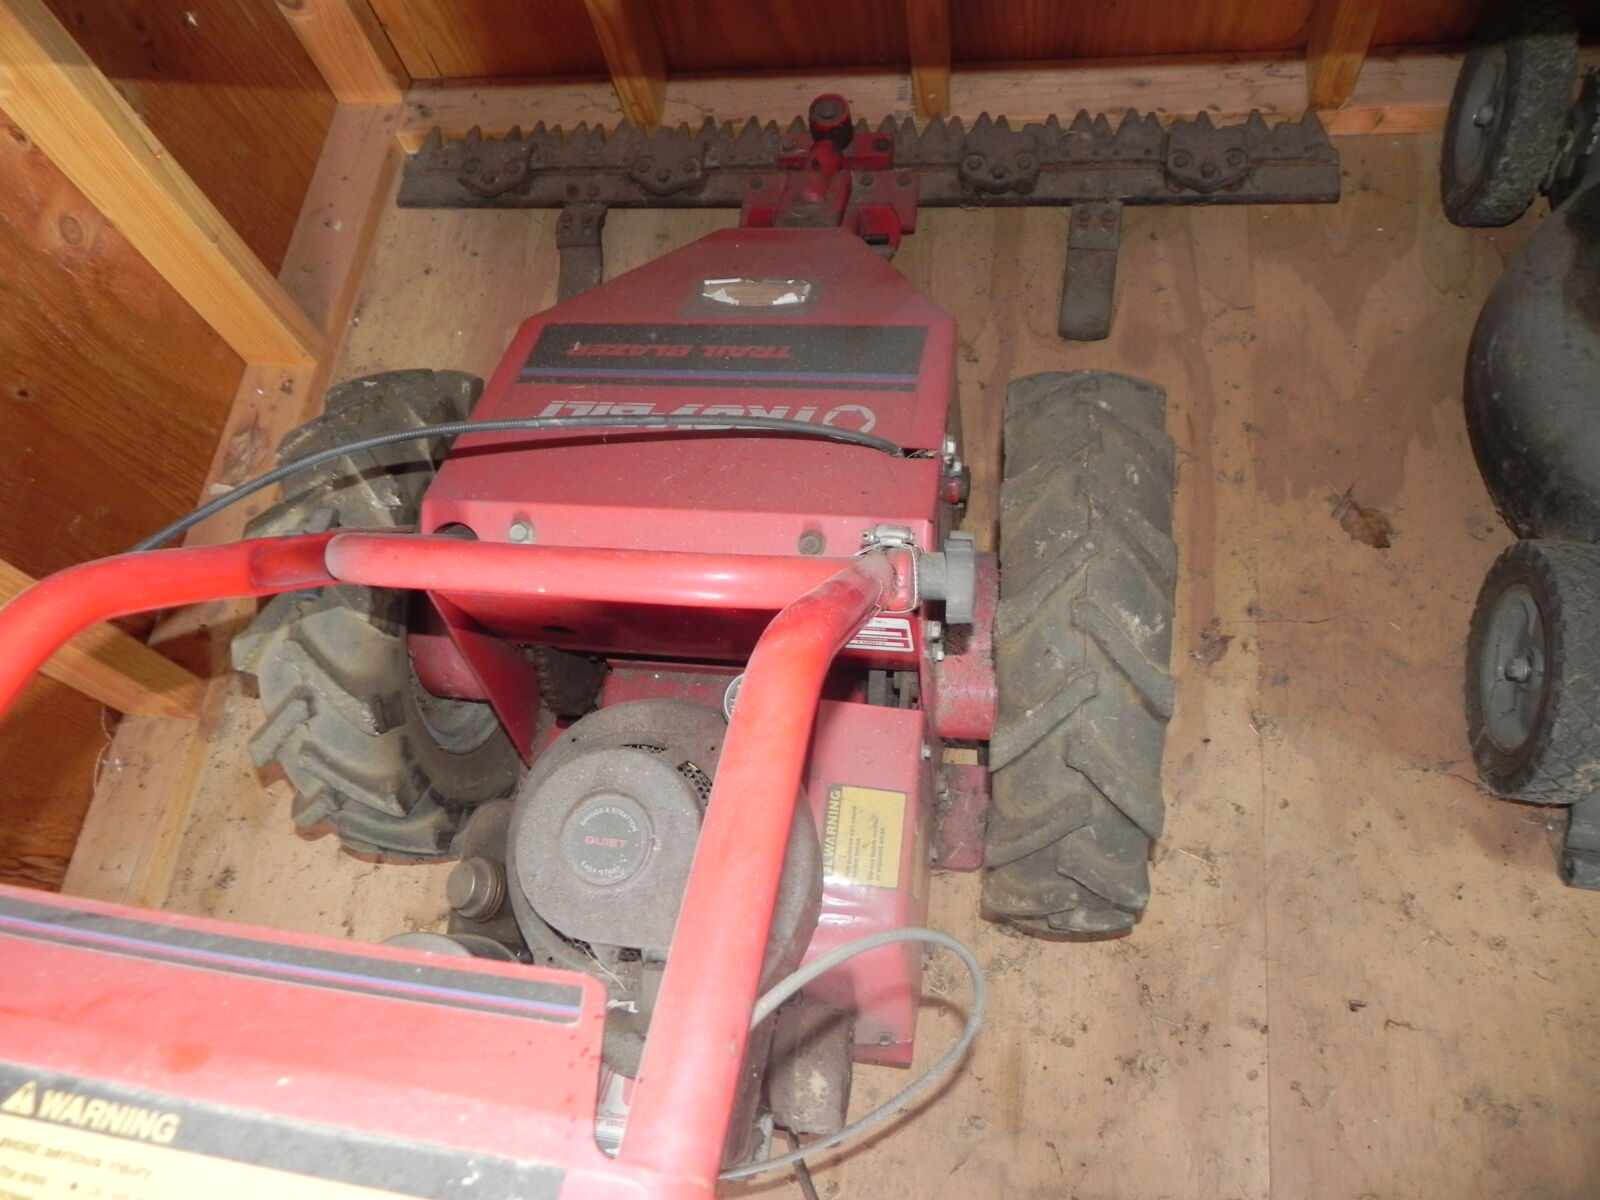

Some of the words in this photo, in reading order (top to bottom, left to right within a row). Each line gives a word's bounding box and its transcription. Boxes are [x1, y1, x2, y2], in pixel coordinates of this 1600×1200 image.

[566, 344, 694, 358] BLAZER
[703, 345, 793, 359] TRAIL
[611, 807, 638, 832] STRATTON
[822, 790, 842, 857] WARNING
[584, 835, 630, 849] QUIET
[38, 1089, 181, 1144] WARNING
